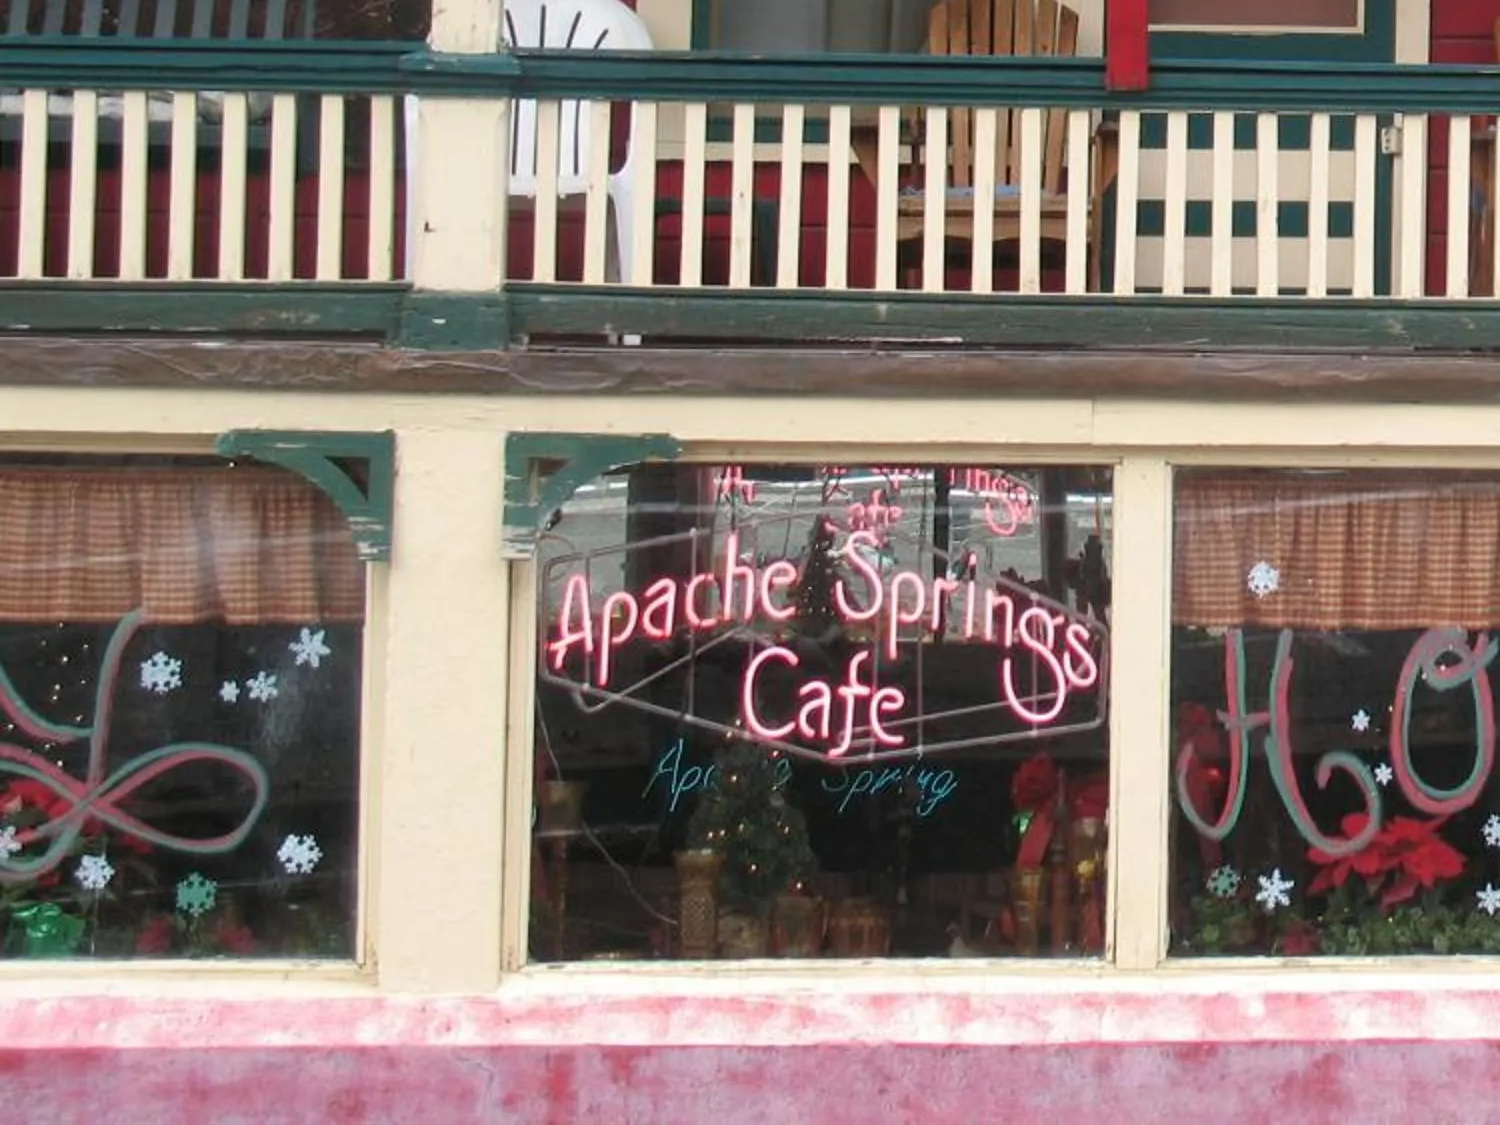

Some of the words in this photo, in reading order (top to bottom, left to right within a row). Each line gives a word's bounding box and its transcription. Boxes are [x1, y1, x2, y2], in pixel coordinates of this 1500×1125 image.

[546, 533, 797, 687] Apache
[834, 529, 1099, 724] Springs
[742, 645, 907, 759] Cafe
